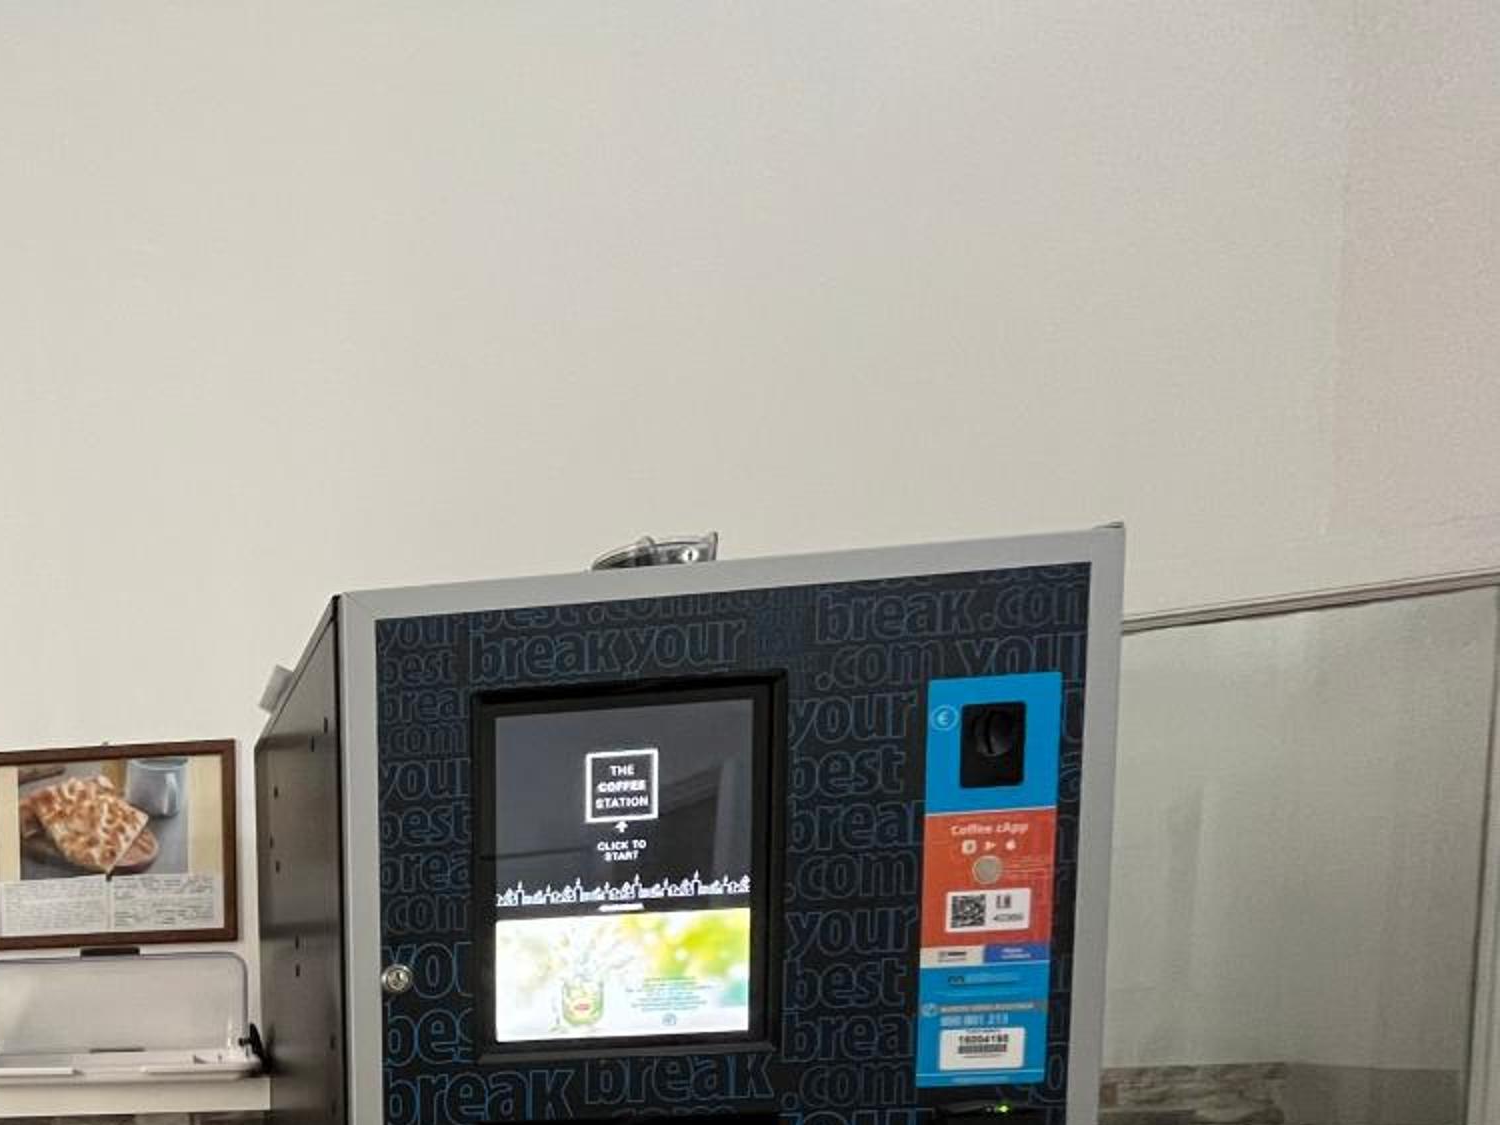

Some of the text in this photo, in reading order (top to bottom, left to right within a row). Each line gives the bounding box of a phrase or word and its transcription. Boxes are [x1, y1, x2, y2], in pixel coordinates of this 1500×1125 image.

[610, 764, 635, 776] THE
[597, 780, 647, 793] COFFEE
[595, 796, 649, 809] STATION
[787, 800, 924, 854] brea
[597, 839, 647, 852] CLICK TO
[603, 851, 639, 861] START
[782, 1010, 917, 1063] brea
